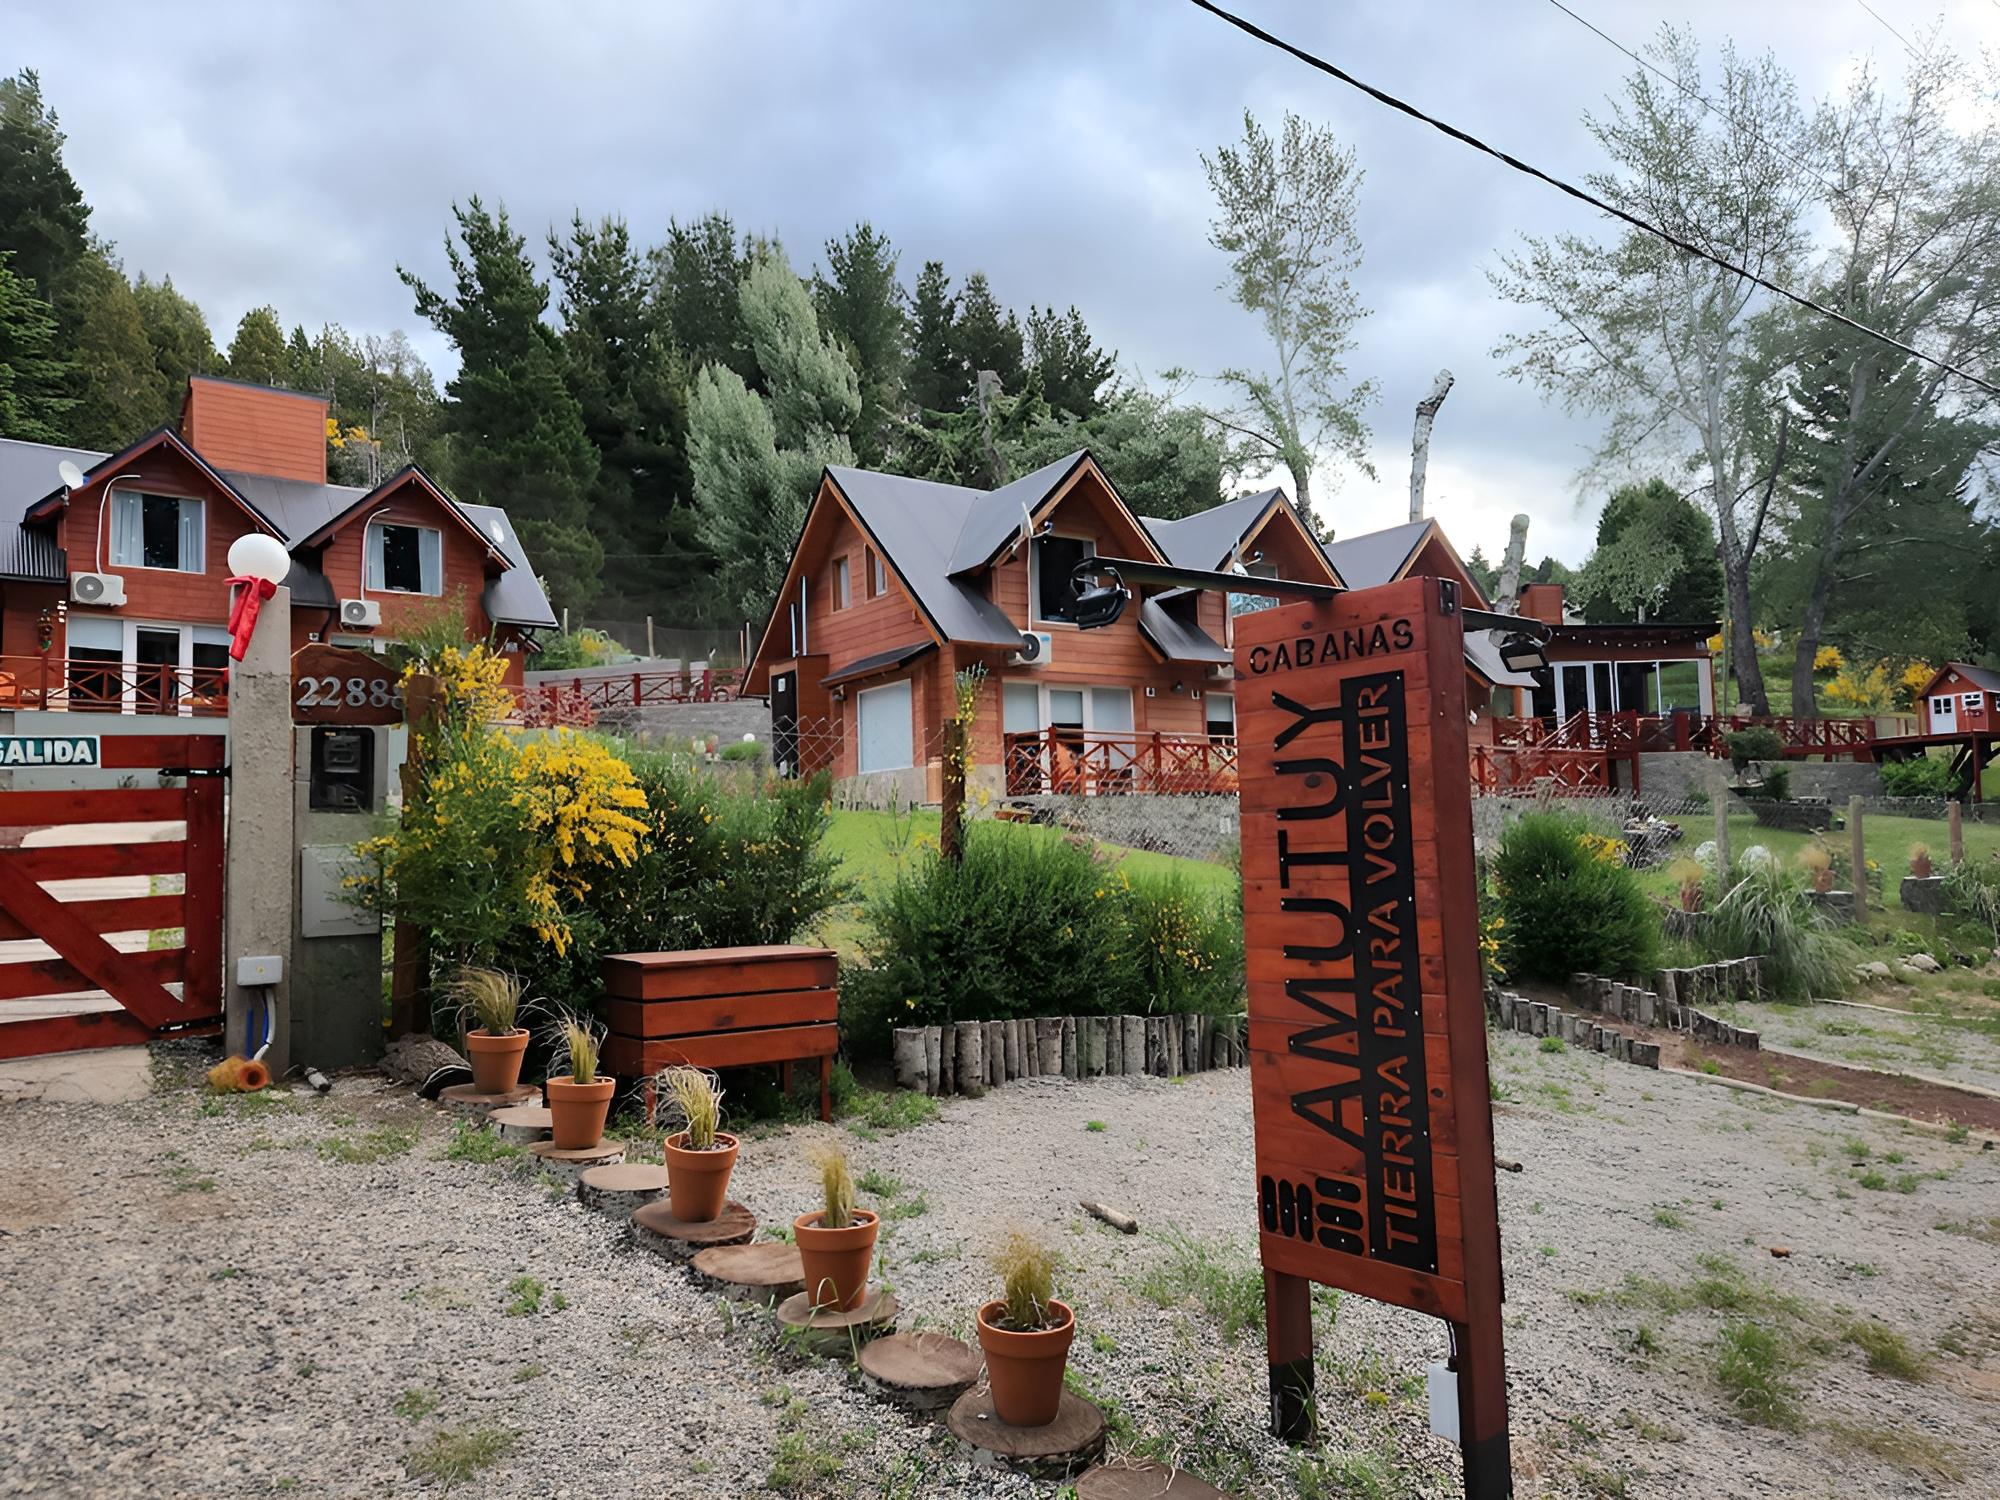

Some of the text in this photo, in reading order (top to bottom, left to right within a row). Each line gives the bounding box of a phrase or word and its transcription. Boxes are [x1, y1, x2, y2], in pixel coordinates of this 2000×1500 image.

[0, 740, 93, 763] ALIDA
[1250, 619, 1414, 674] CABANAS
[1272, 690, 1366, 1153] AMUTUY
[1358, 683, 1419, 1250] TIERRA PARA VOLVER
